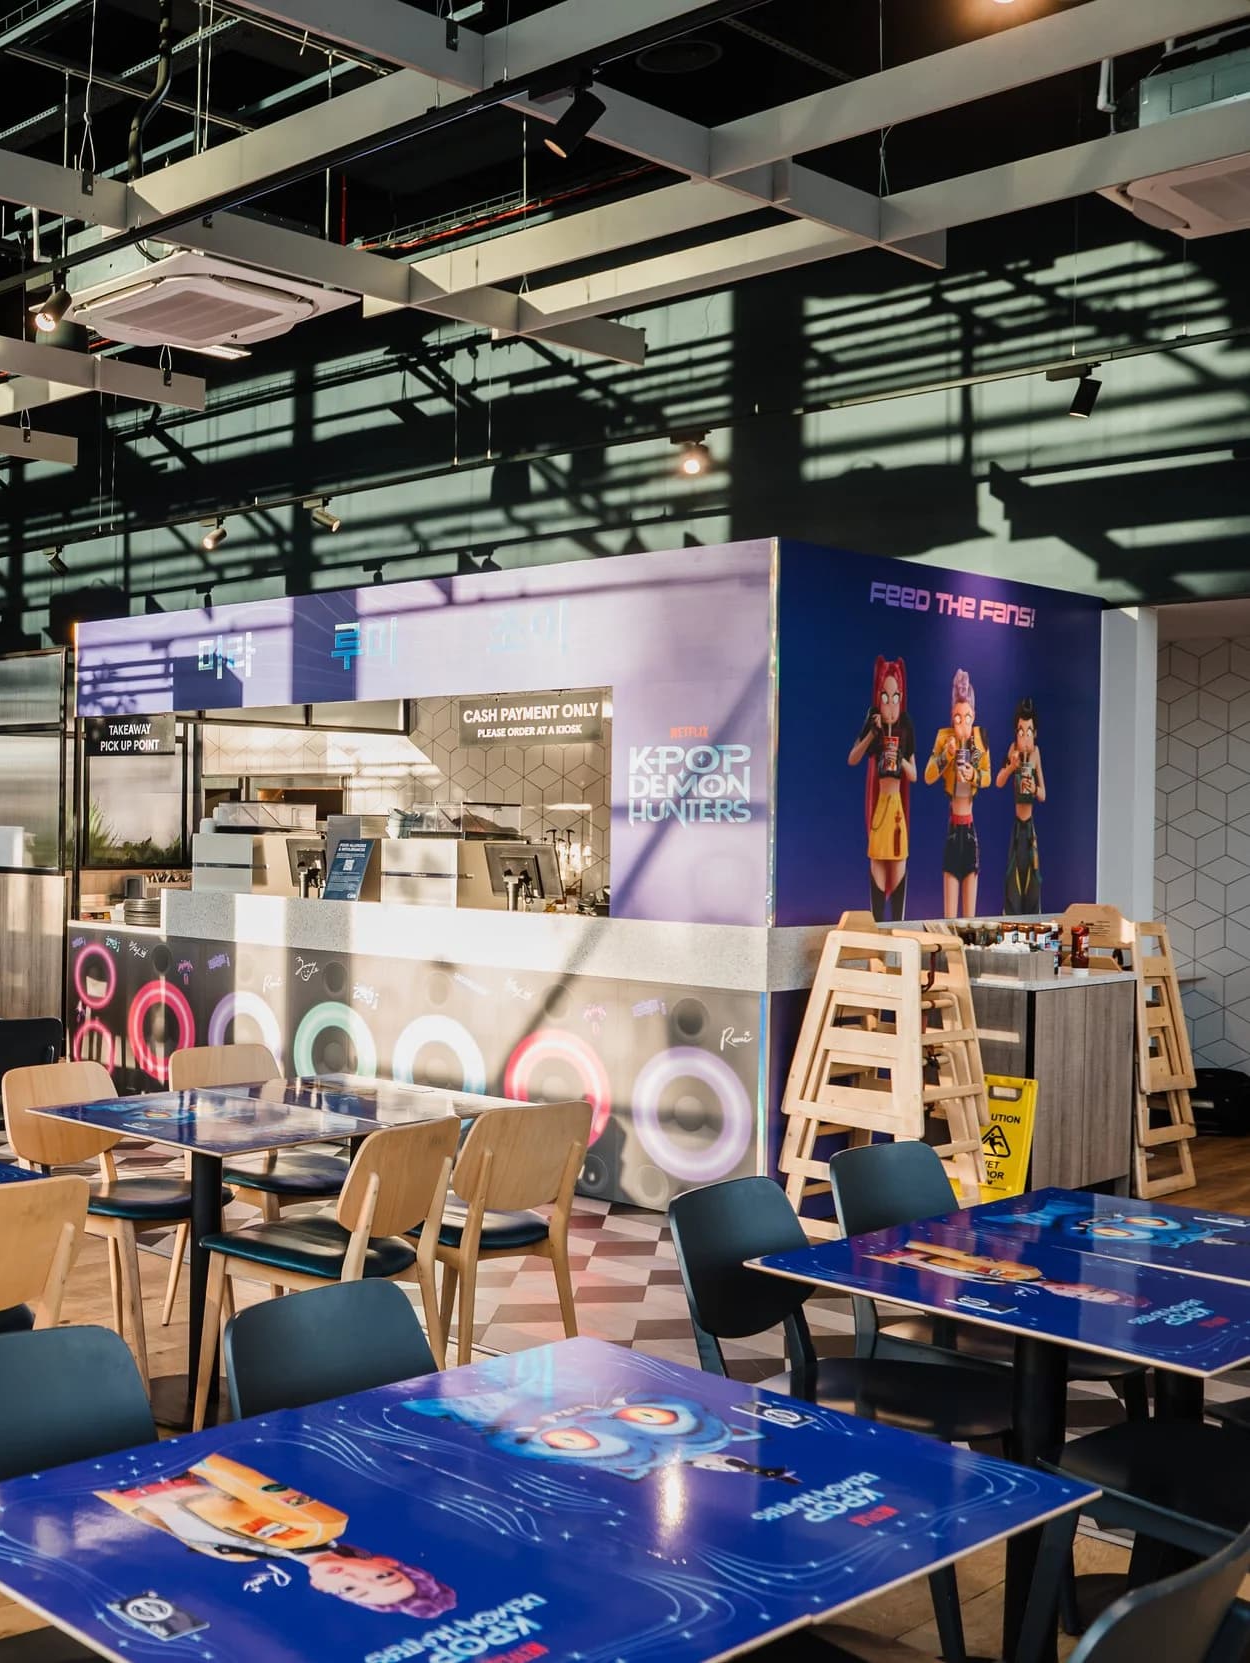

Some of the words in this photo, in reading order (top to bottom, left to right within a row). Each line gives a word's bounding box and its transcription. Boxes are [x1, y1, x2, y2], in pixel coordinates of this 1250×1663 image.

[463, 708, 498, 723] CASH
[500, 705, 560, 721] PAYMENT
[562, 702, 599, 717] ONLY
[109, 723, 151, 736] TAKEAWAY
[477, 727, 506, 738] PLEASE
[507, 726, 535, 737] ORDER
[536, 725, 547, 735] AT
[547, 725, 555, 735] A
[556, 723, 582, 735] KIOSK
[100, 740, 119, 752] PICK
[120, 740, 132, 751] UP
[133, 739, 159, 751] POINT
[629, 766, 751, 803] DEMON
[628, 798, 752, 829] HUNTERS
[991, 1113, 1021, 1124] UTION
